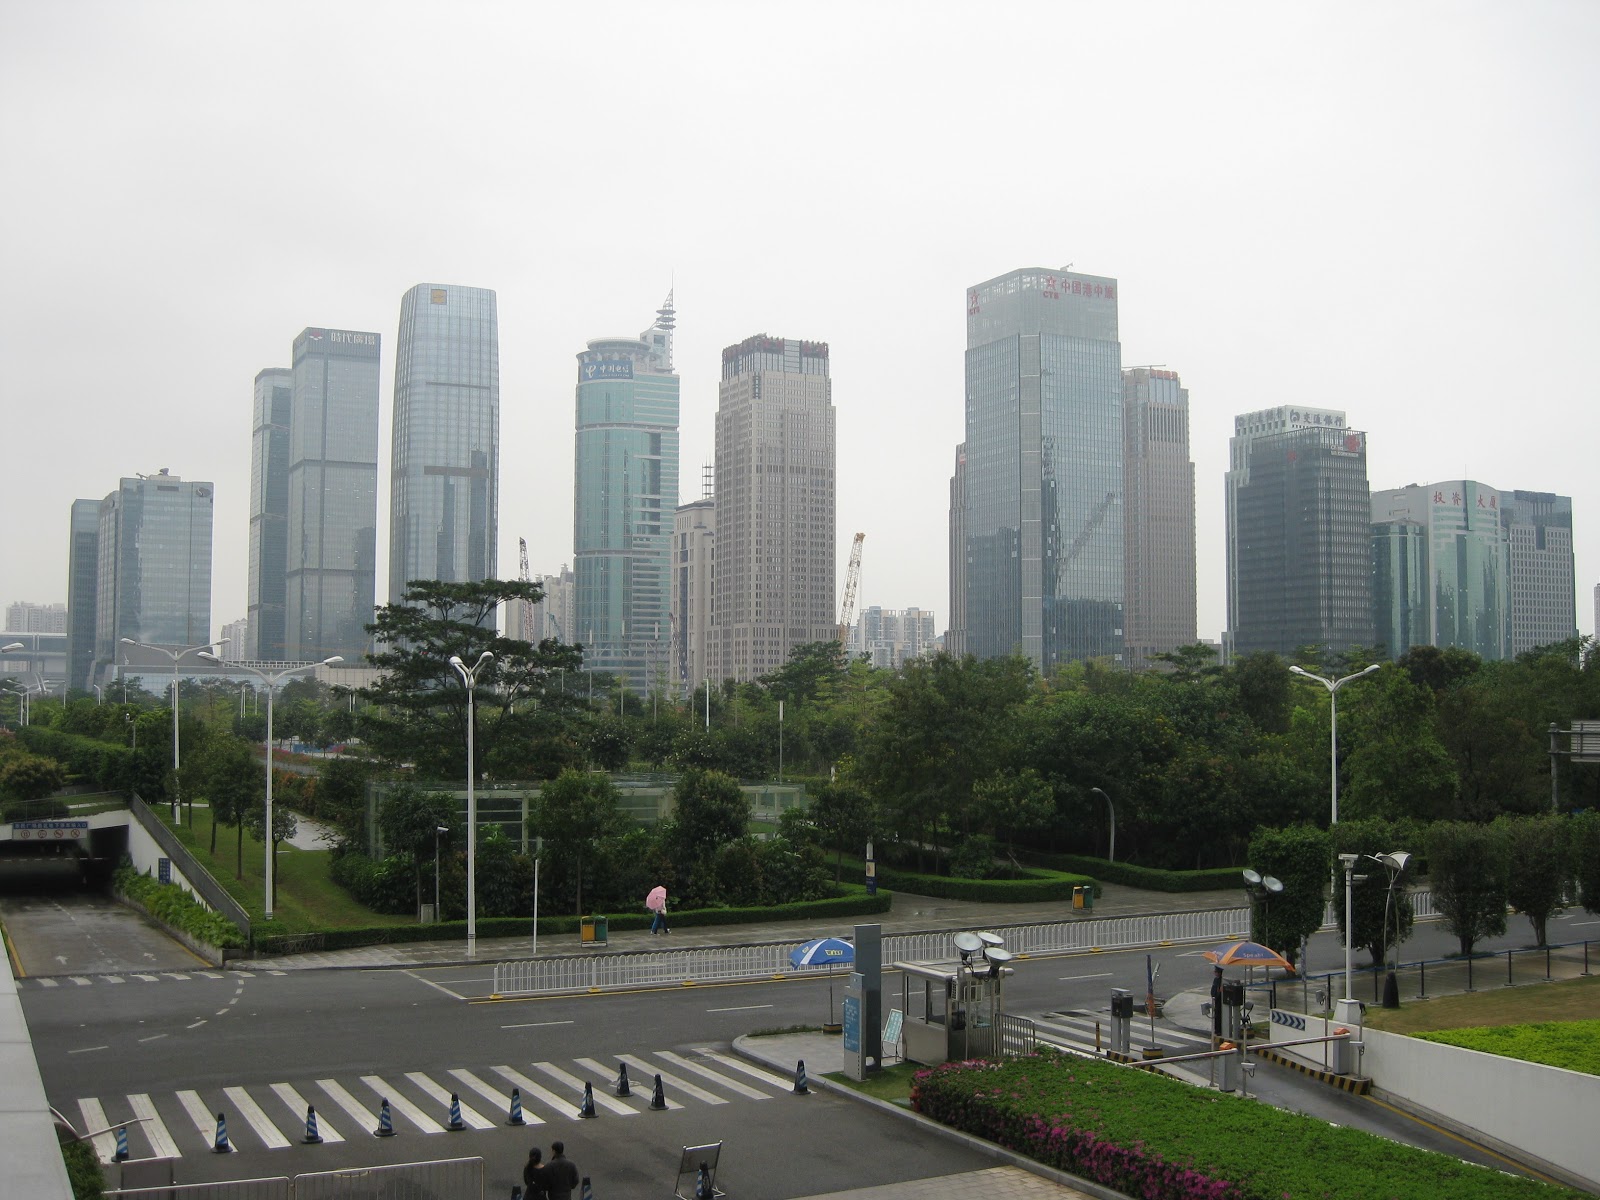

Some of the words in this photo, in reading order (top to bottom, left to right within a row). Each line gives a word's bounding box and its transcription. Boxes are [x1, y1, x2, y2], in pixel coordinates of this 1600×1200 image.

[1062, 279, 1115, 299] 中国港中旅
